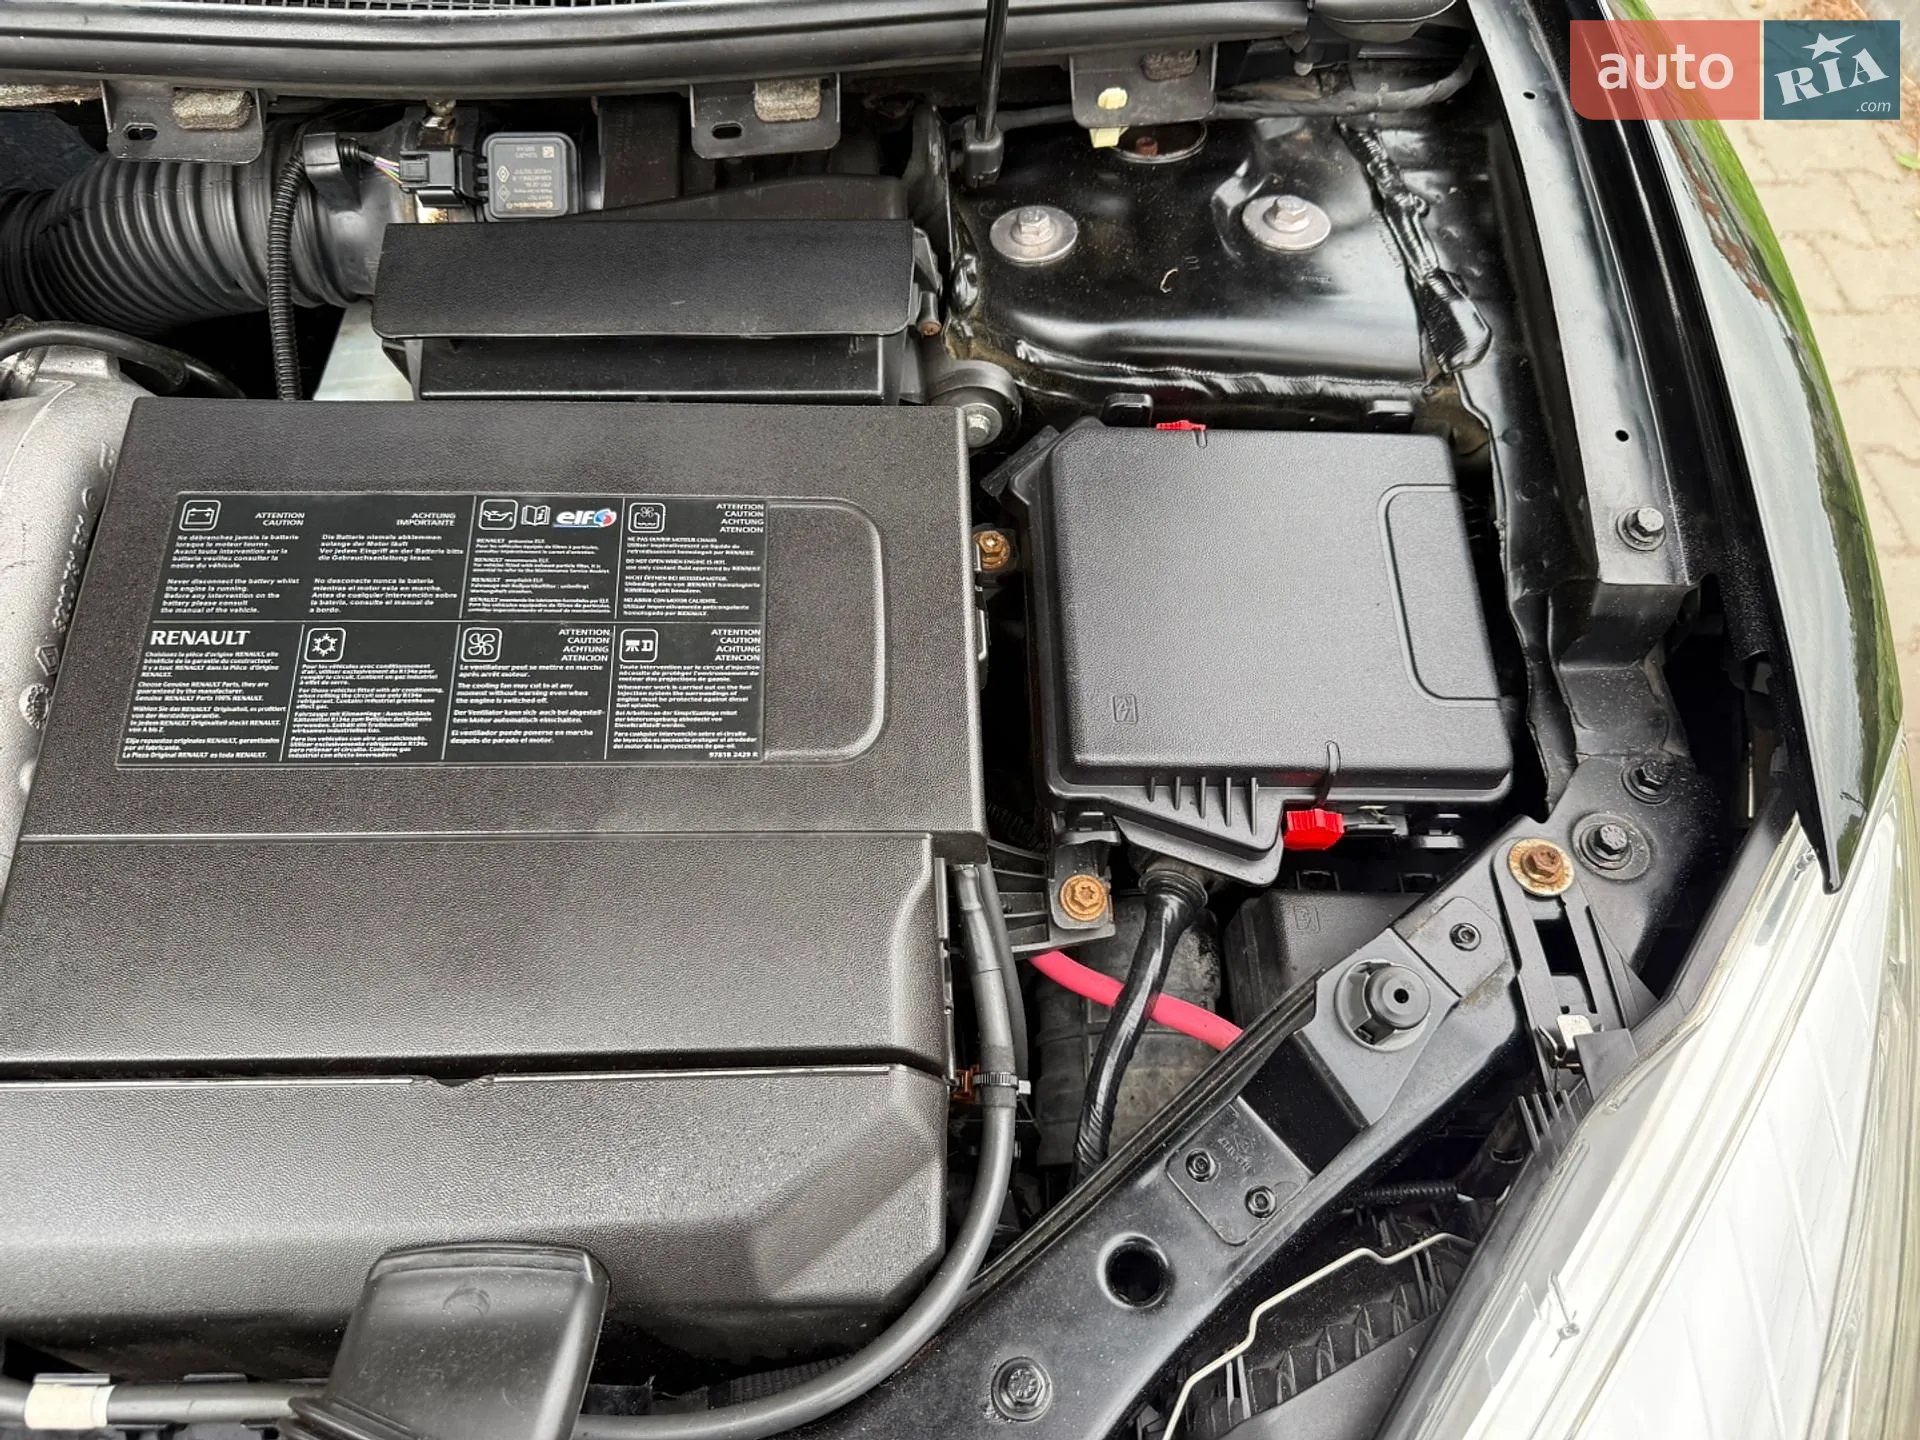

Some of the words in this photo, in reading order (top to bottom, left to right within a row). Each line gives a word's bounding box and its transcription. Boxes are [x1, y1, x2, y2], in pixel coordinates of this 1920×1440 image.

[254, 511, 305, 519] ATTENTION
[411, 511, 456, 519] ACHTUNG
[556, 510, 595, 525] elf
[396, 518, 456, 526] IMPORTANTE
[150, 630, 251, 645] RENAULT
[719, 637, 761, 645] CAUTION
[562, 645, 609, 653] ACHTUNG
[715, 645, 761, 653] ACHTUNG
